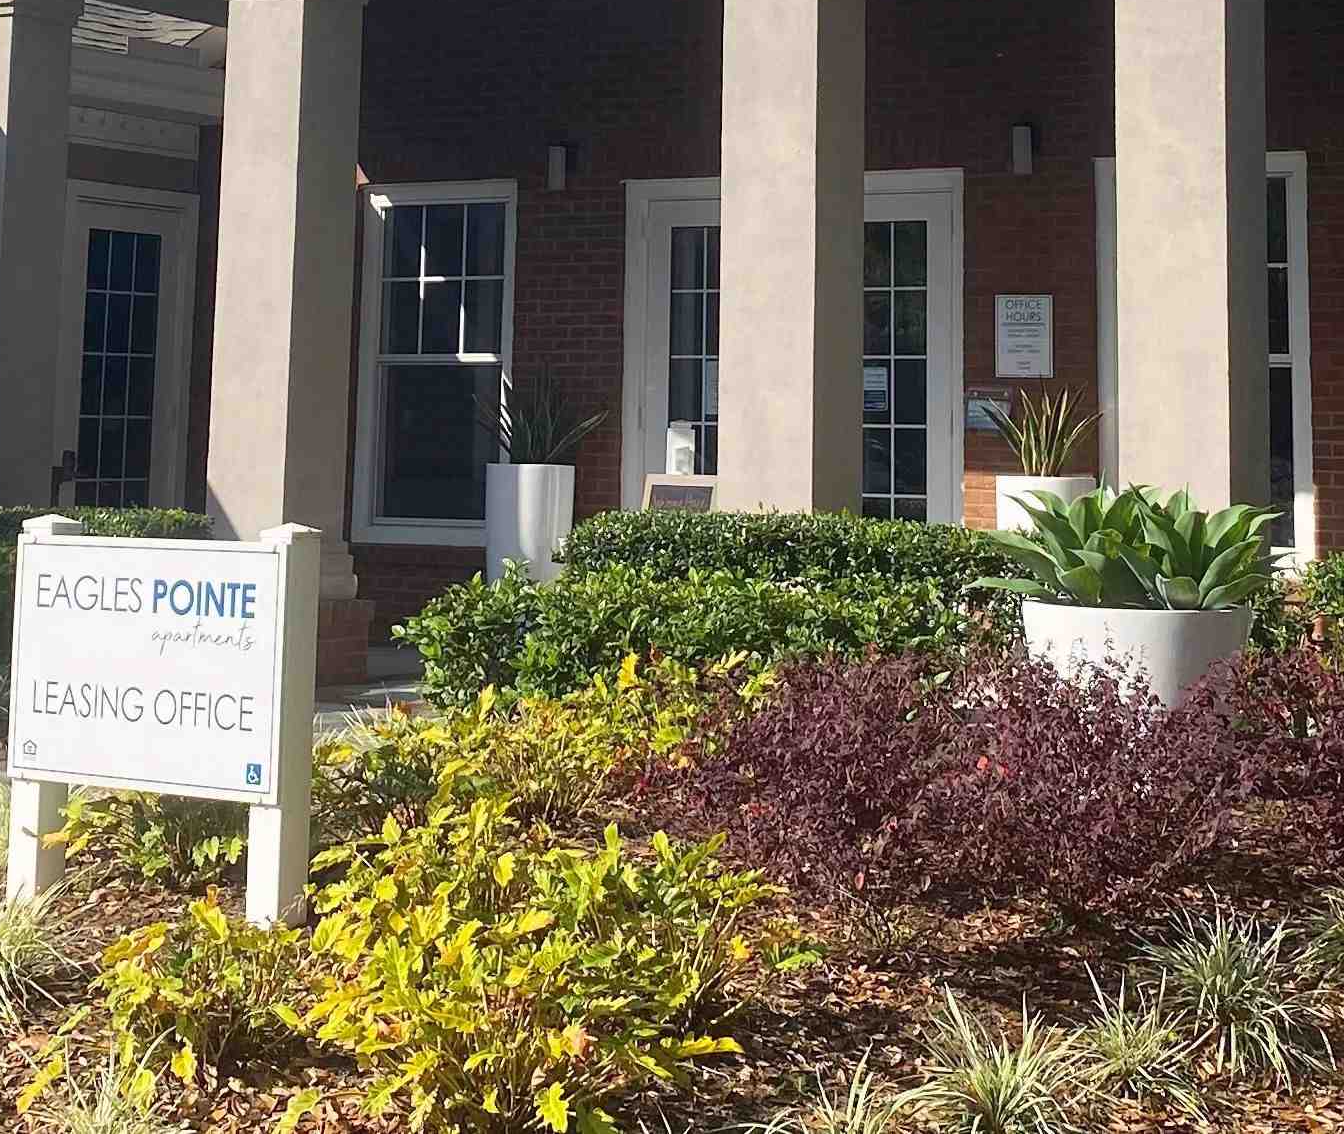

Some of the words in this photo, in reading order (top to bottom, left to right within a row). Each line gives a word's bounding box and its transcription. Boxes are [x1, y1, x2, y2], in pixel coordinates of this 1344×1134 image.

[1006, 299, 1041, 310] OFFICE
[1006, 311, 1041, 322] HOURS
[37, 574, 143, 612] EAGLES
[152, 579, 256, 618] POINTE
[151, 619, 255, 656] apartments
[32, 680, 144, 722] LEASING
[154, 689, 254, 732] OFFICE
